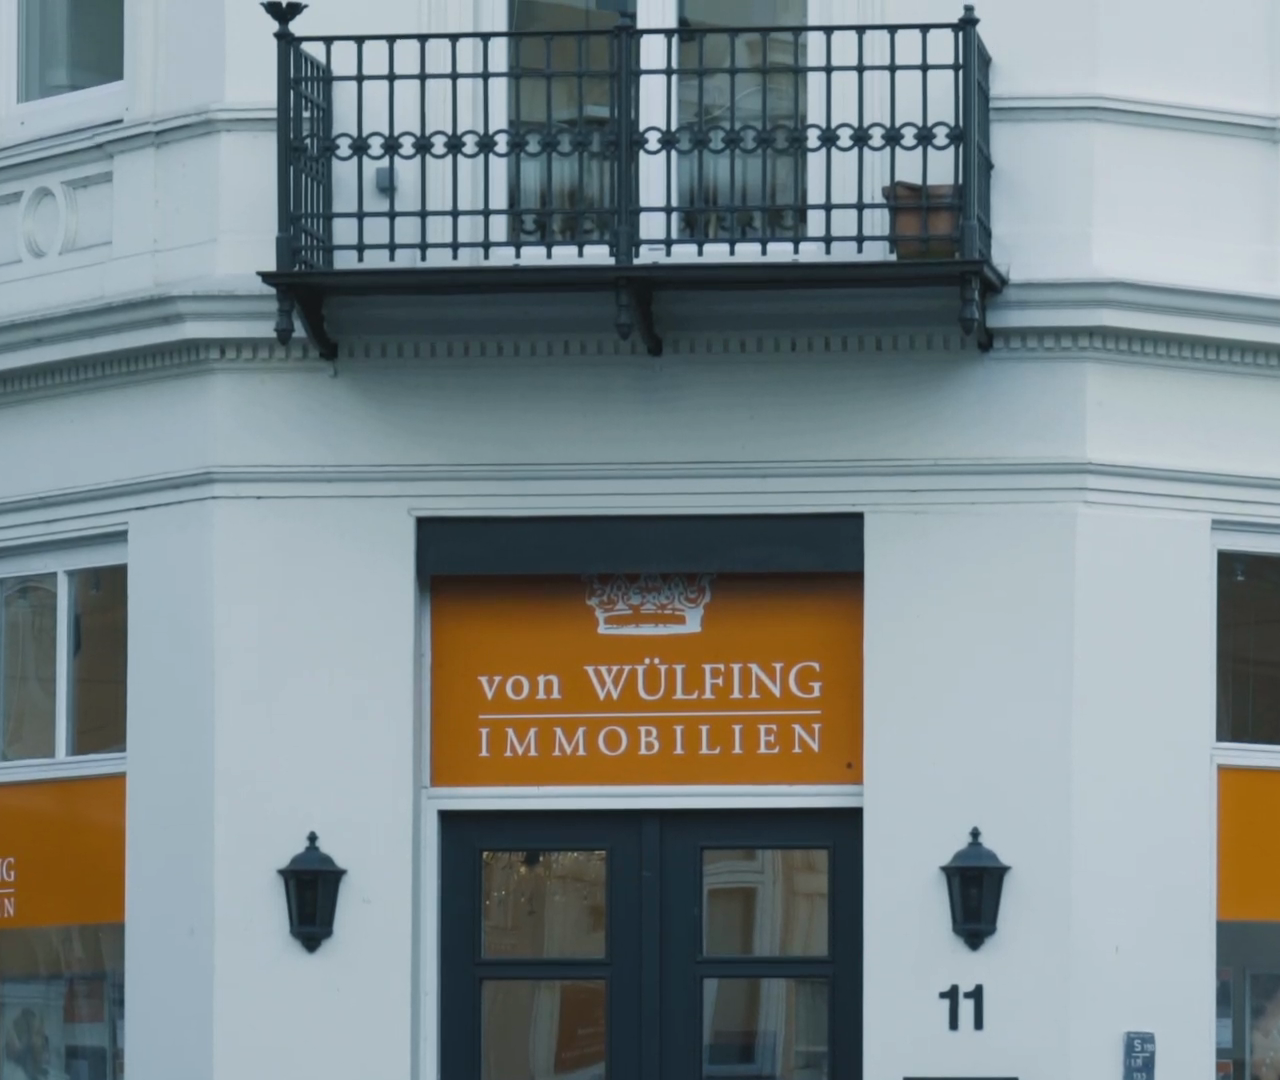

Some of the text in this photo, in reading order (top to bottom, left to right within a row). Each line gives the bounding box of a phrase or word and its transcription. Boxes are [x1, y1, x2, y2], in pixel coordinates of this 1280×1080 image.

[478, 657, 823, 701] von WÜLFING
[478, 723, 823, 757] IMMOBILIEN
[938, 983, 984, 1031] 11
